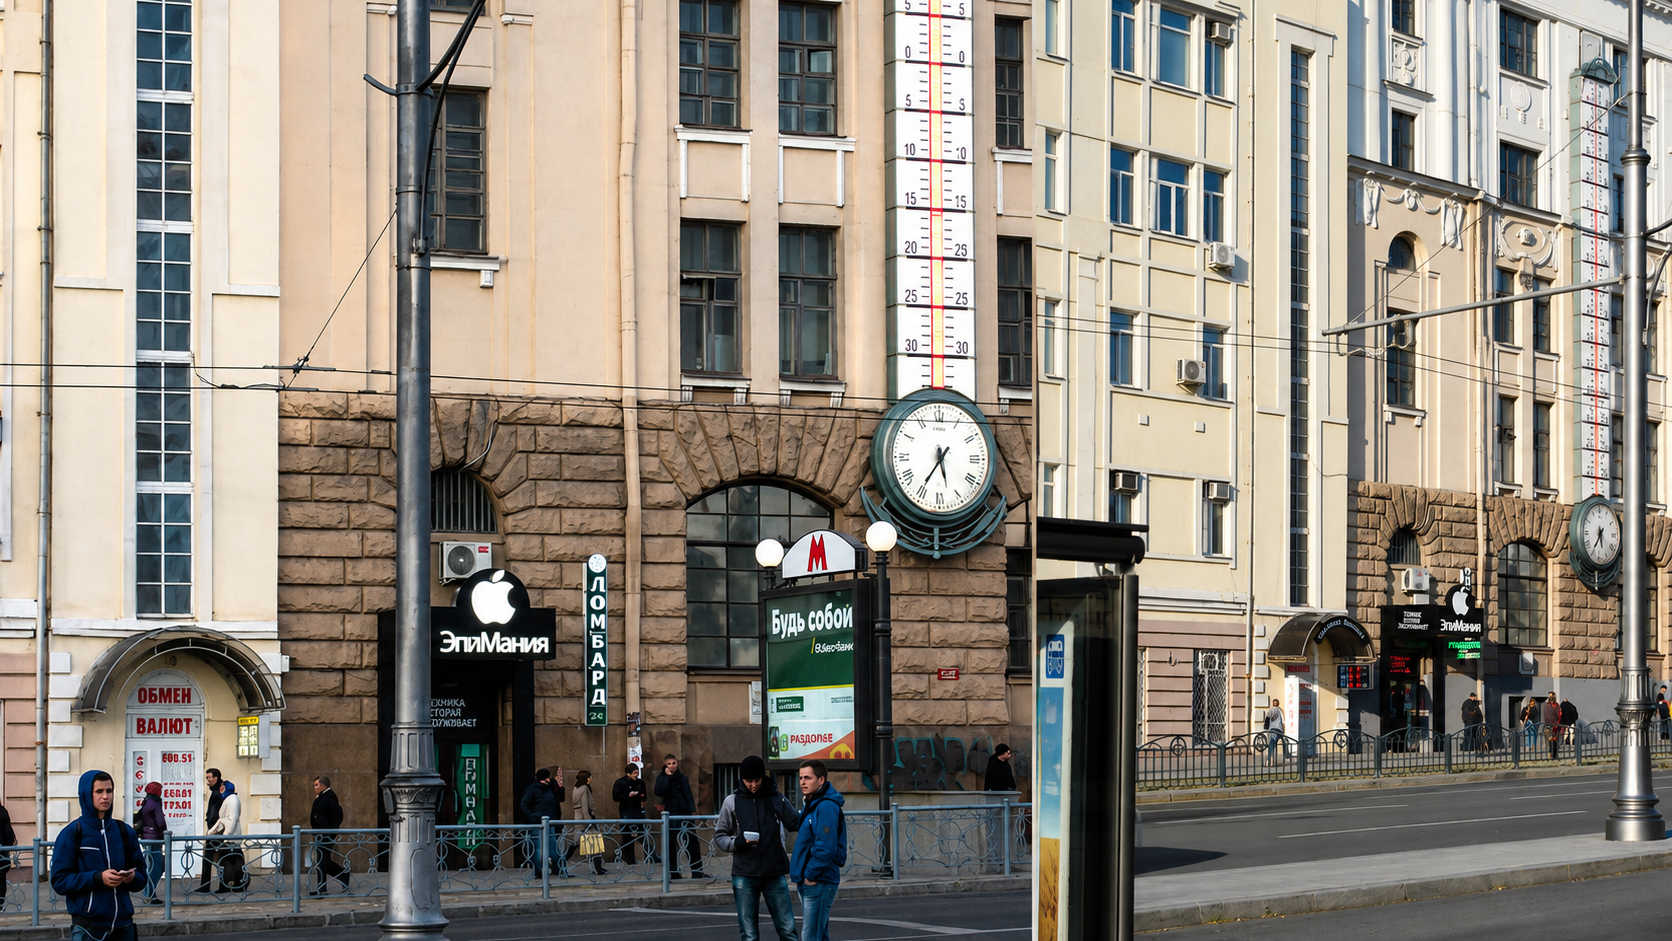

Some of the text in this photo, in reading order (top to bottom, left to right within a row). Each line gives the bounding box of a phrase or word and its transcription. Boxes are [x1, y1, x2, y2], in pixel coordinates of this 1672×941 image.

[959, 3, 965, 15] 5
[904, 45, 911, 59] 0
[959, 50, 965, 63] 0
[905, 94, 912, 107] 5
[904, 143, 916, 156] 10
[956, 146, 967, 160] 10
[905, 192, 917, 205] 15
[955, 195, 967, 209] 15
[904, 241, 917, 254] 20
[904, 289, 918, 303] 25
[955, 292, 968, 305] 25
[904, 338, 918, 352] 30
[955, 341, 969, 354] 30
[807, 533, 828, 573] М
[772, 608, 806, 640] Будь
[1440, 618, 1482, 633] ЭпиМания
[439, 630, 550, 653] ЭпиМания
[589, 576, 606, 706] ЛОМБАРД
[137, 687, 192, 704] ОБМЕН
[136, 718, 193, 735] ВАЛЮТ
